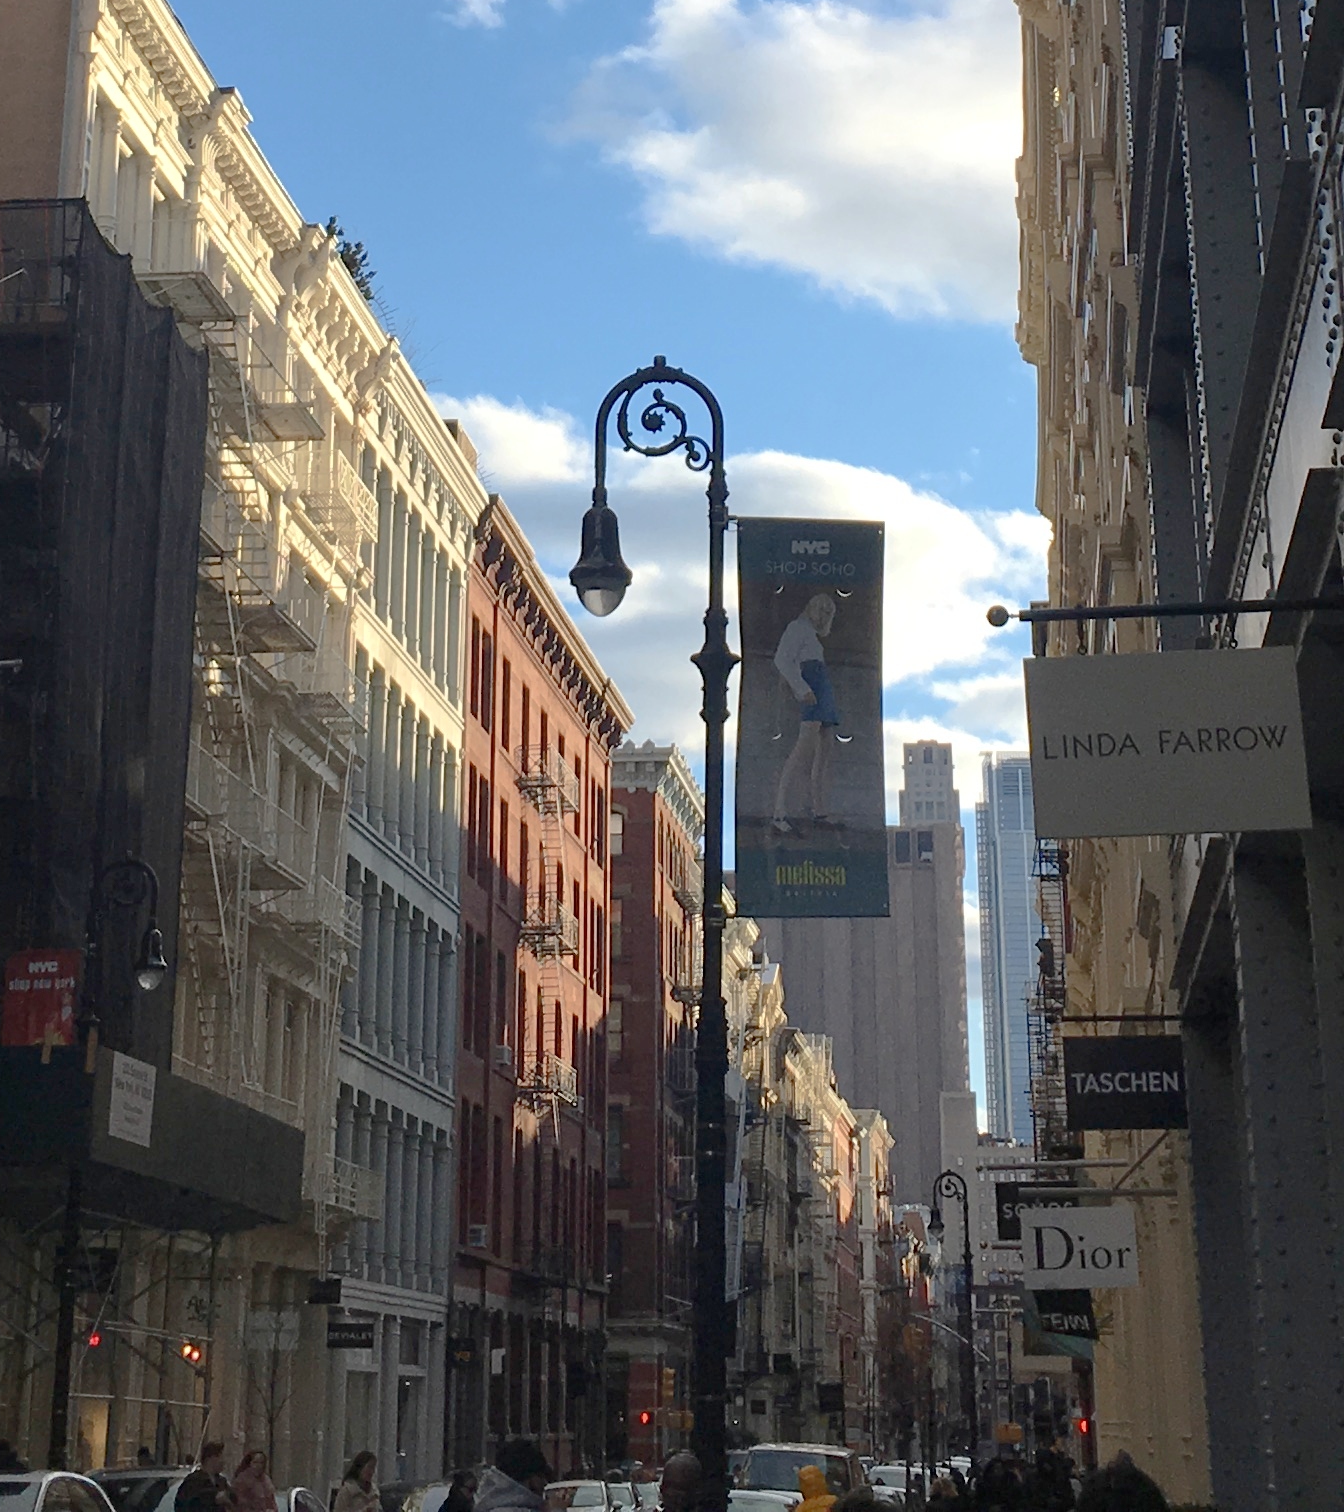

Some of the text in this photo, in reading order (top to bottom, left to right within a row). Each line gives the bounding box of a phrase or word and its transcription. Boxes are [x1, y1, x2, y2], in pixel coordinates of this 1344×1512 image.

[791, 540, 830, 554] NYC
[766, 559, 856, 576] SHOP SOHO
[1042, 725, 1288, 760] LINDA FARROW
[776, 859, 847, 887] melissa
[28, 961, 58, 974] NYC
[1071, 1071, 1179, 1094] TASCHEN
[1029, 1226, 1131, 1270] Dior
